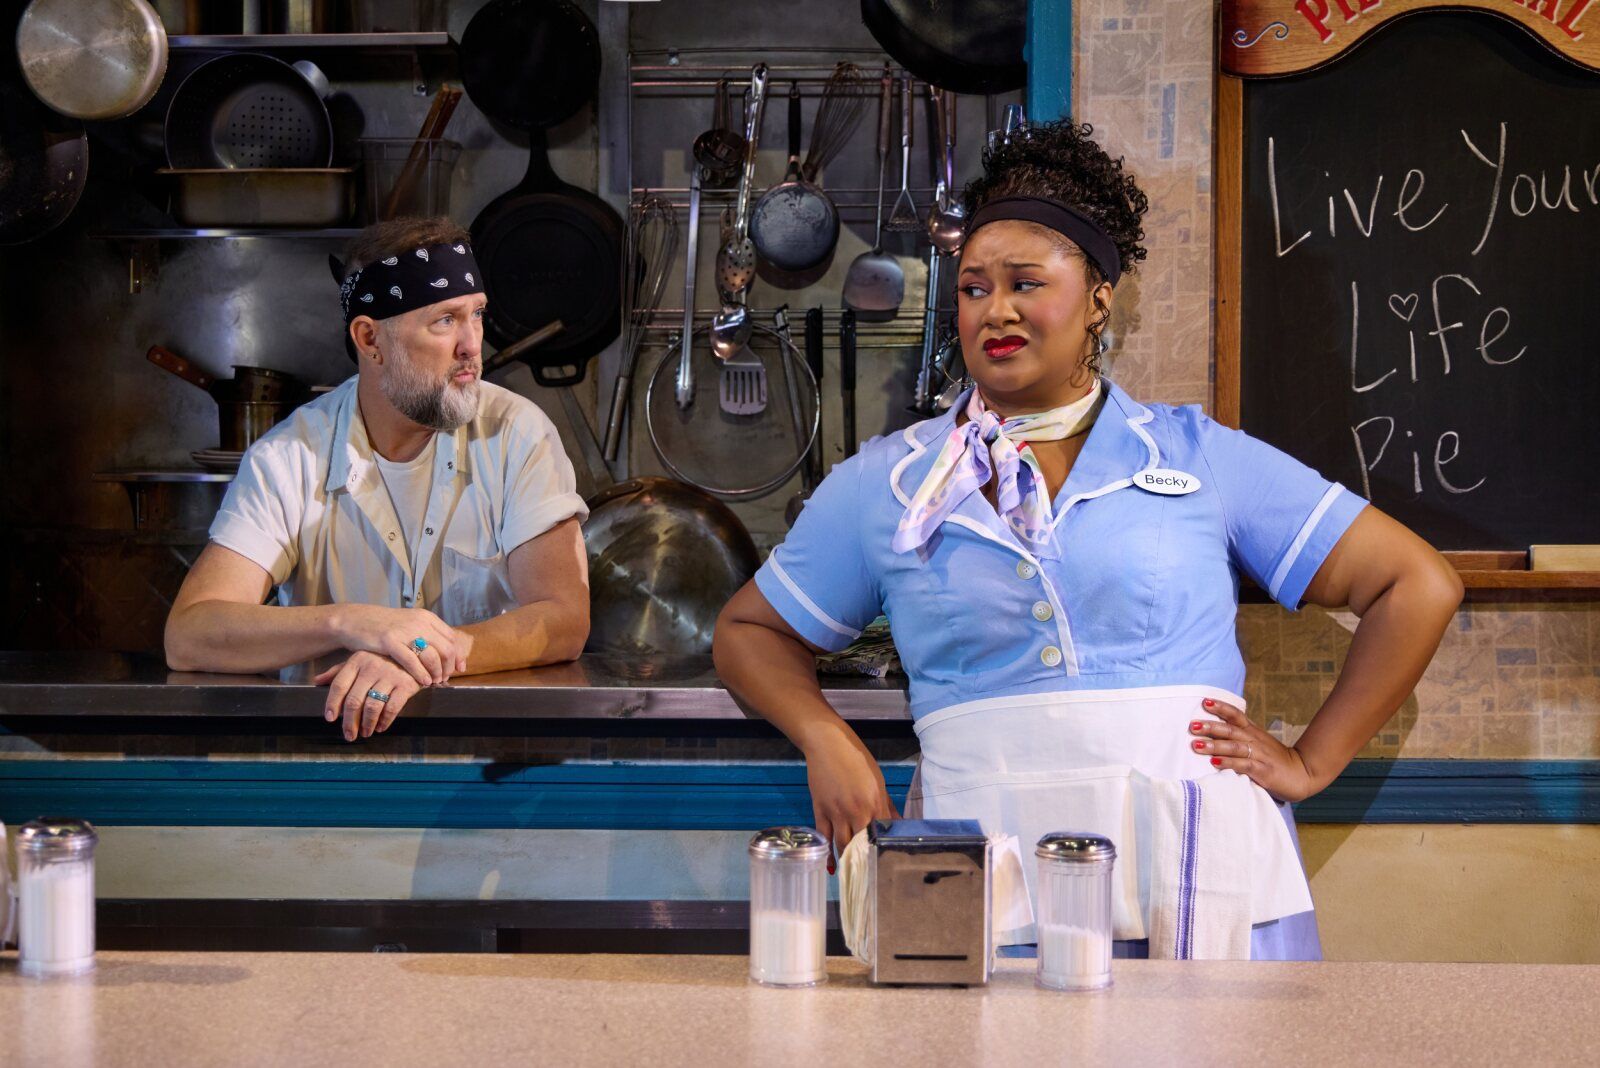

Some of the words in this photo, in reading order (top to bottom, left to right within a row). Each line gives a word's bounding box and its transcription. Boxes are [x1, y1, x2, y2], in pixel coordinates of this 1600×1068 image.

[1267, 136, 1448, 258] Live
[1351, 273, 1527, 393] Life
[1144, 474, 1189, 489] Becky
[1350, 415, 1487, 500] Pie
